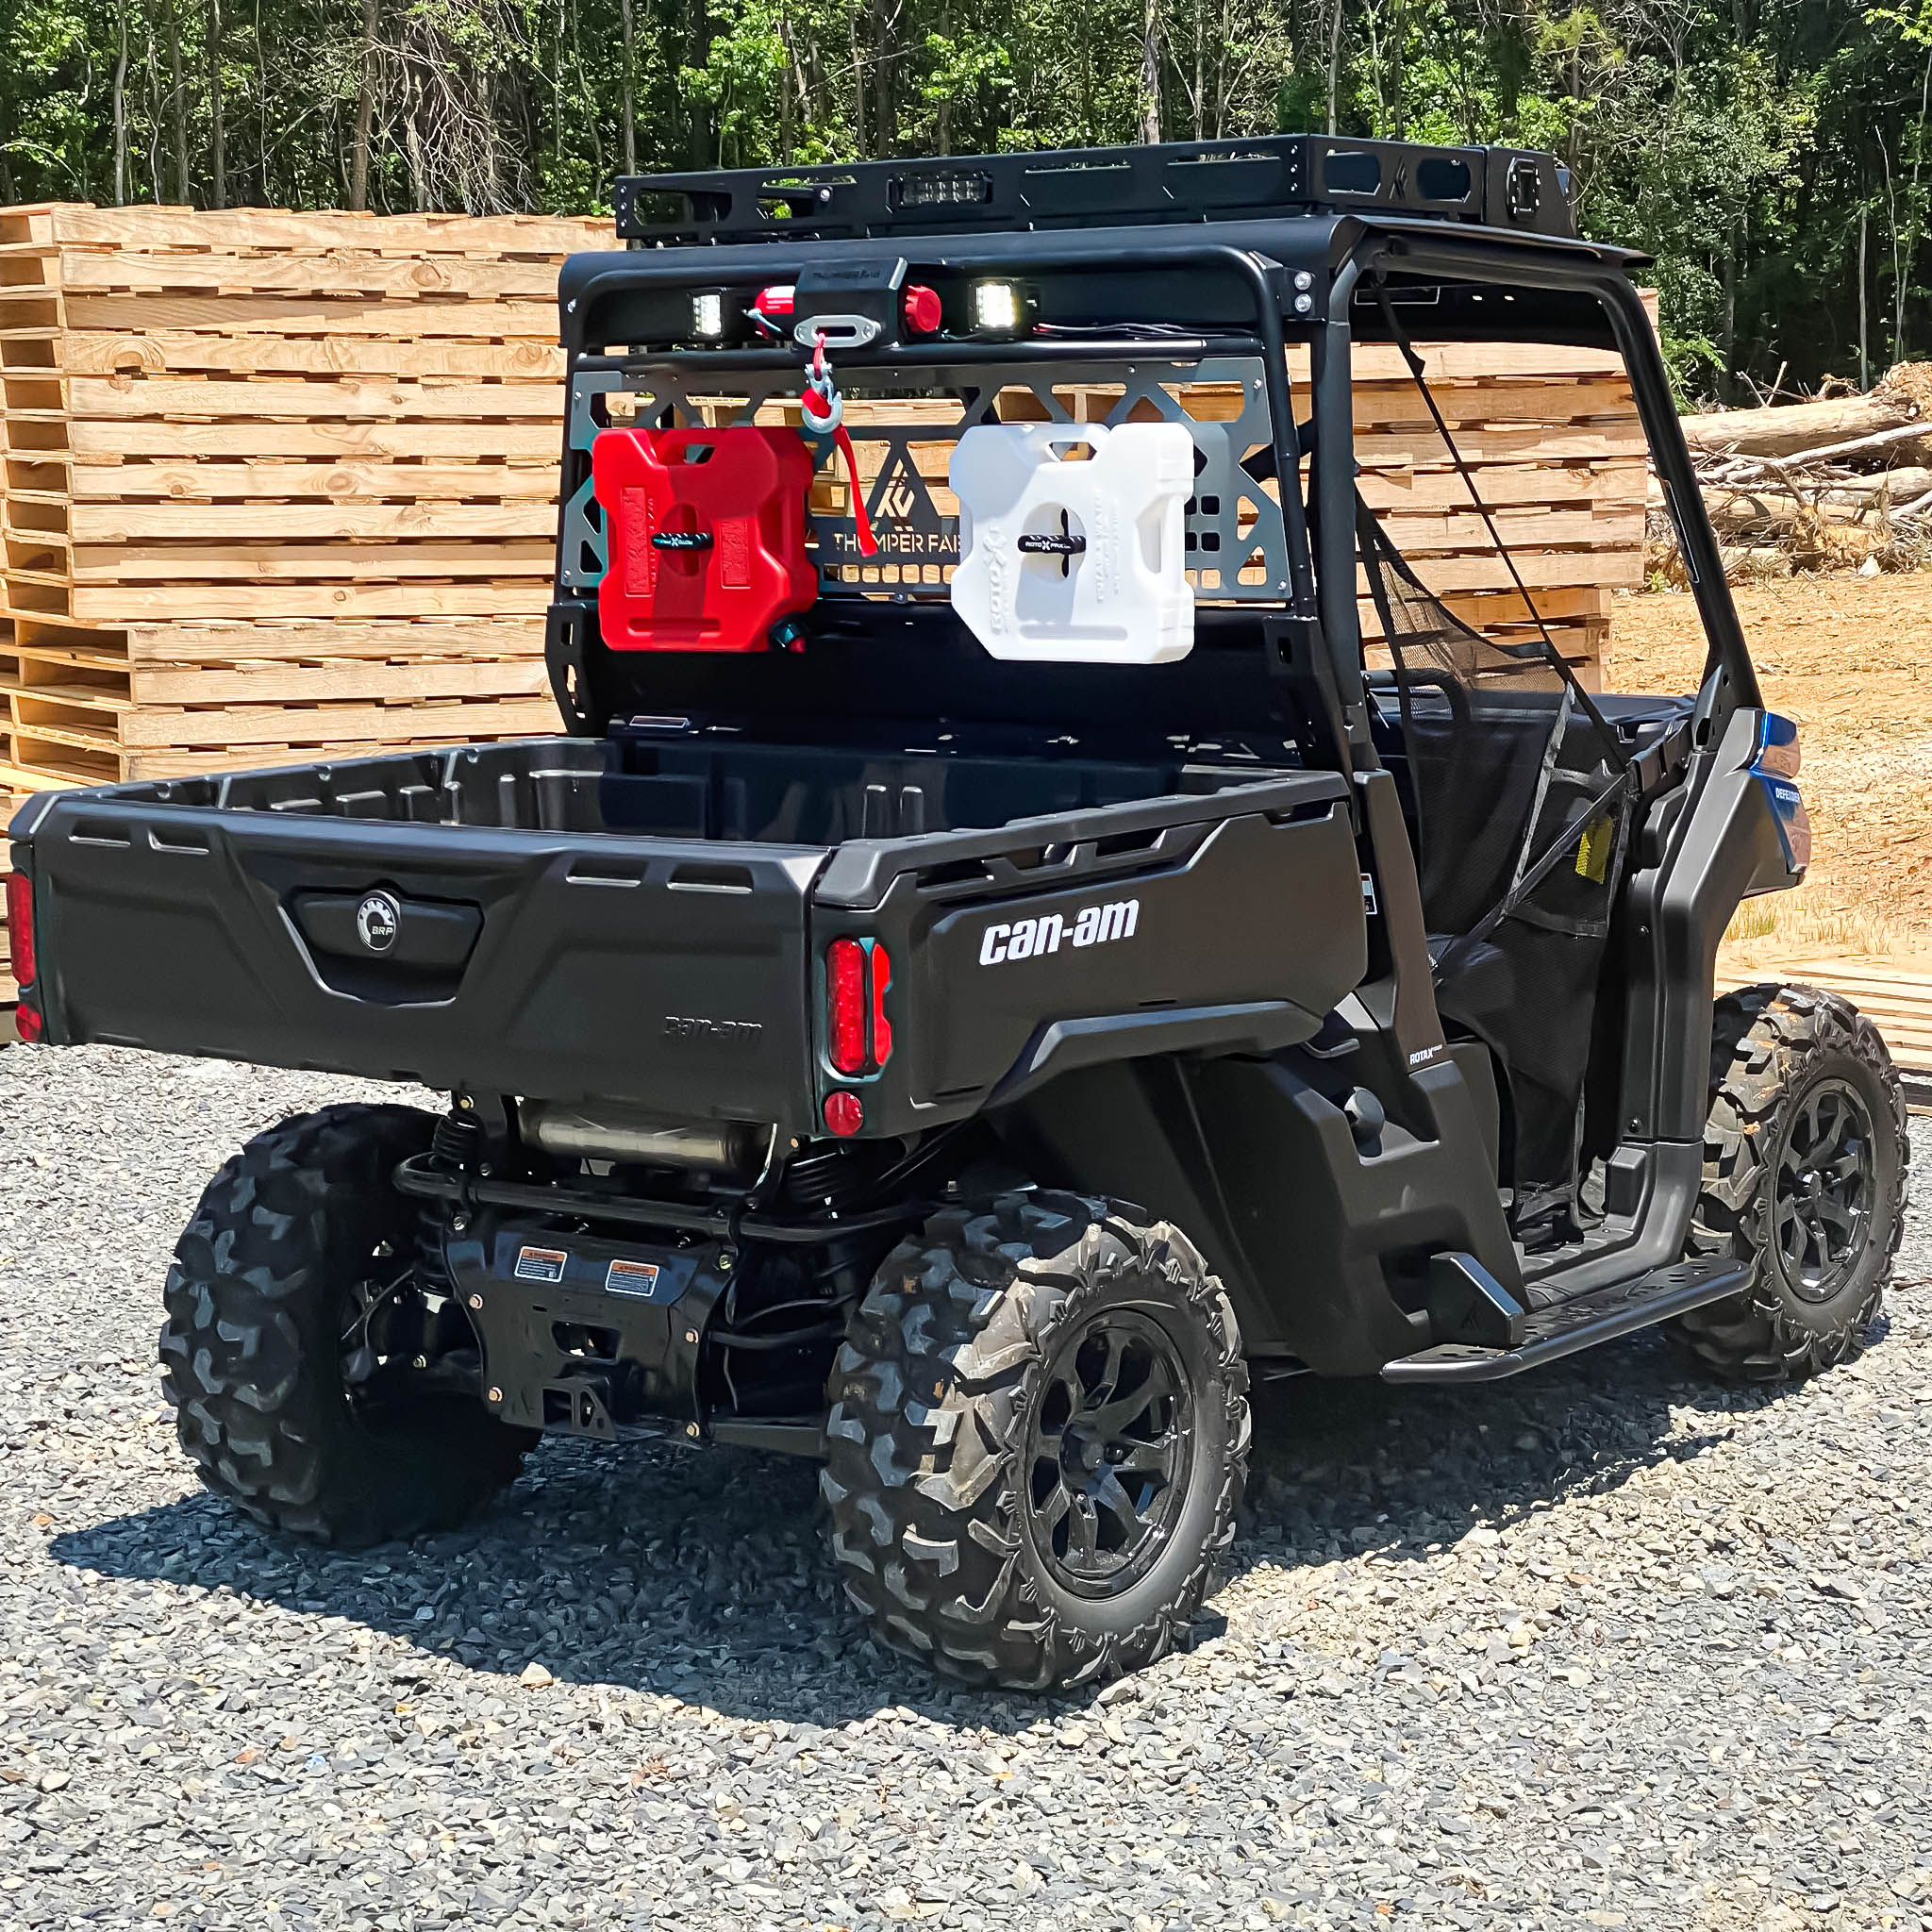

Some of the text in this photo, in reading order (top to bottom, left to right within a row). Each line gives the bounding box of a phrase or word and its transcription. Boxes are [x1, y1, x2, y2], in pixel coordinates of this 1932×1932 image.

[834, 532, 924, 553] THMPER
[372, 925, 393, 936] BRP
[979, 899, 1140, 966] can-am
[1409, 1047, 1434, 1065] ROTAX
